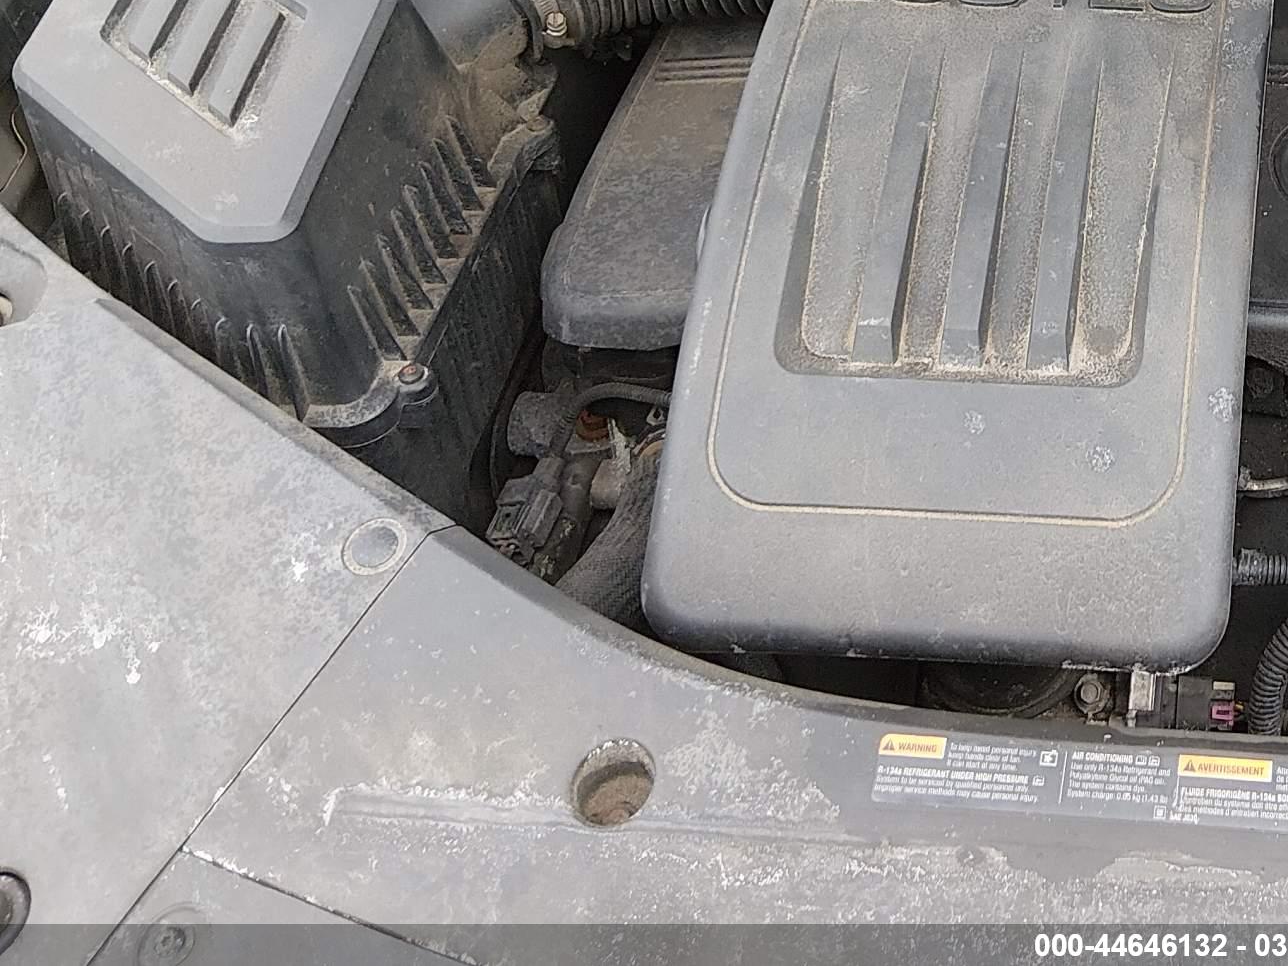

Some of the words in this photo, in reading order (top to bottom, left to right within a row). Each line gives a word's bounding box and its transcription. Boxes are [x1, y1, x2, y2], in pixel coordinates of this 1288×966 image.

[899, 742, 936, 753] WARNING
[991, 746, 1018, 756] personal
[1072, 751, 1084, 760] AIR
[1086, 752, 1133, 763] CONDITIONING
[903, 767, 950, 778] REFRIGERANT
[951, 771, 974, 780] UNDER
[975, 773, 992, 781] HIGH
[993, 774, 1028, 784] PRESSURE
[1084, 763, 1097, 772] only
[1159, 768, 1170, 776] and
[1198, 763, 1264, 776] AVERTISSEMENT
[1082, 781, 1104, 790] system
[991, 792, 1019, 801] personal
[1067, 790, 1091, 799] System
[1132, 794, 1141, 802] kg
